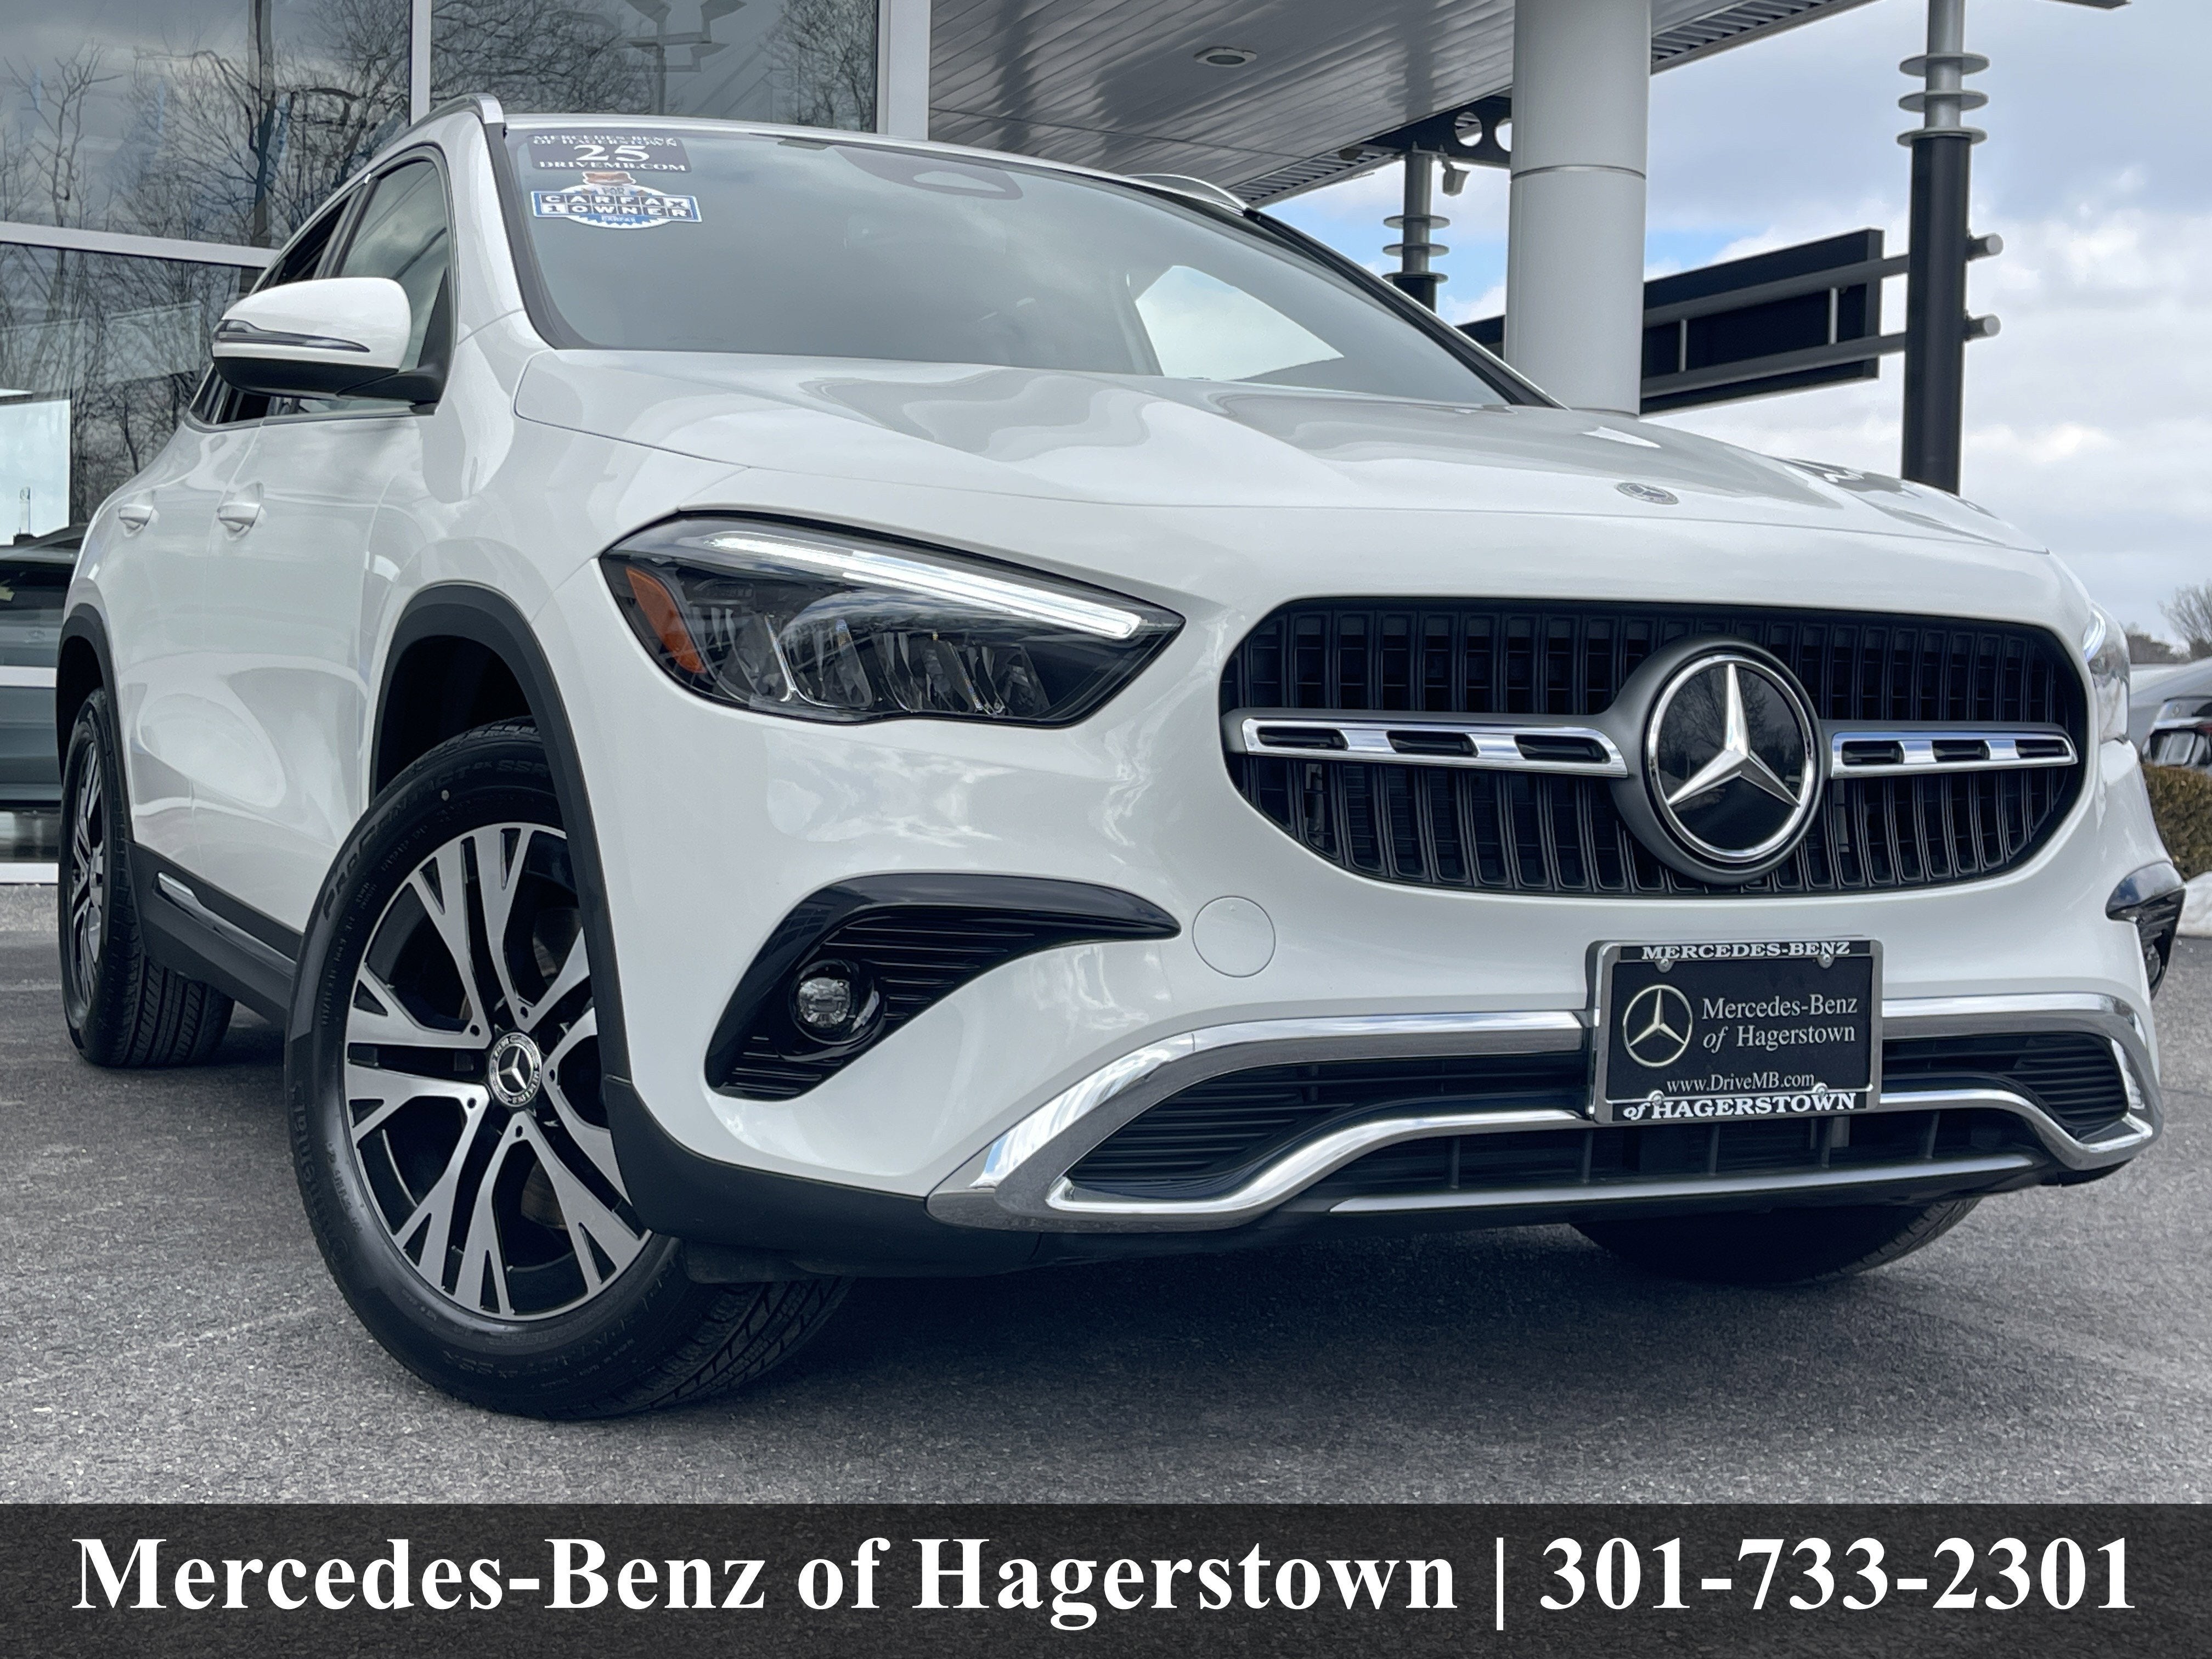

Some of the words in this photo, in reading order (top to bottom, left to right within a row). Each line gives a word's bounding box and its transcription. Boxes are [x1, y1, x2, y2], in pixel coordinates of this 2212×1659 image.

[574, 144, 650, 162] 25
[539, 161, 686, 171] DRIVEMB.COM
[545, 195, 687, 208] CARFAX
[548, 205, 561, 213] 1
[572, 205, 688, 217] OWNER
[1641, 941, 1850, 960] MERCEDES-BENZ
[1701, 994, 1858, 1020] Mercedes-Benz
[1702, 1026, 1728, 1053] of
[1736, 1025, 1856, 1052] Hagerstown
[1667, 1071, 1815, 1093] www.DriveMB.com
[1623, 1102, 1651, 1121] of
[1650, 1093, 1857, 1120] HAGERSTOWN
